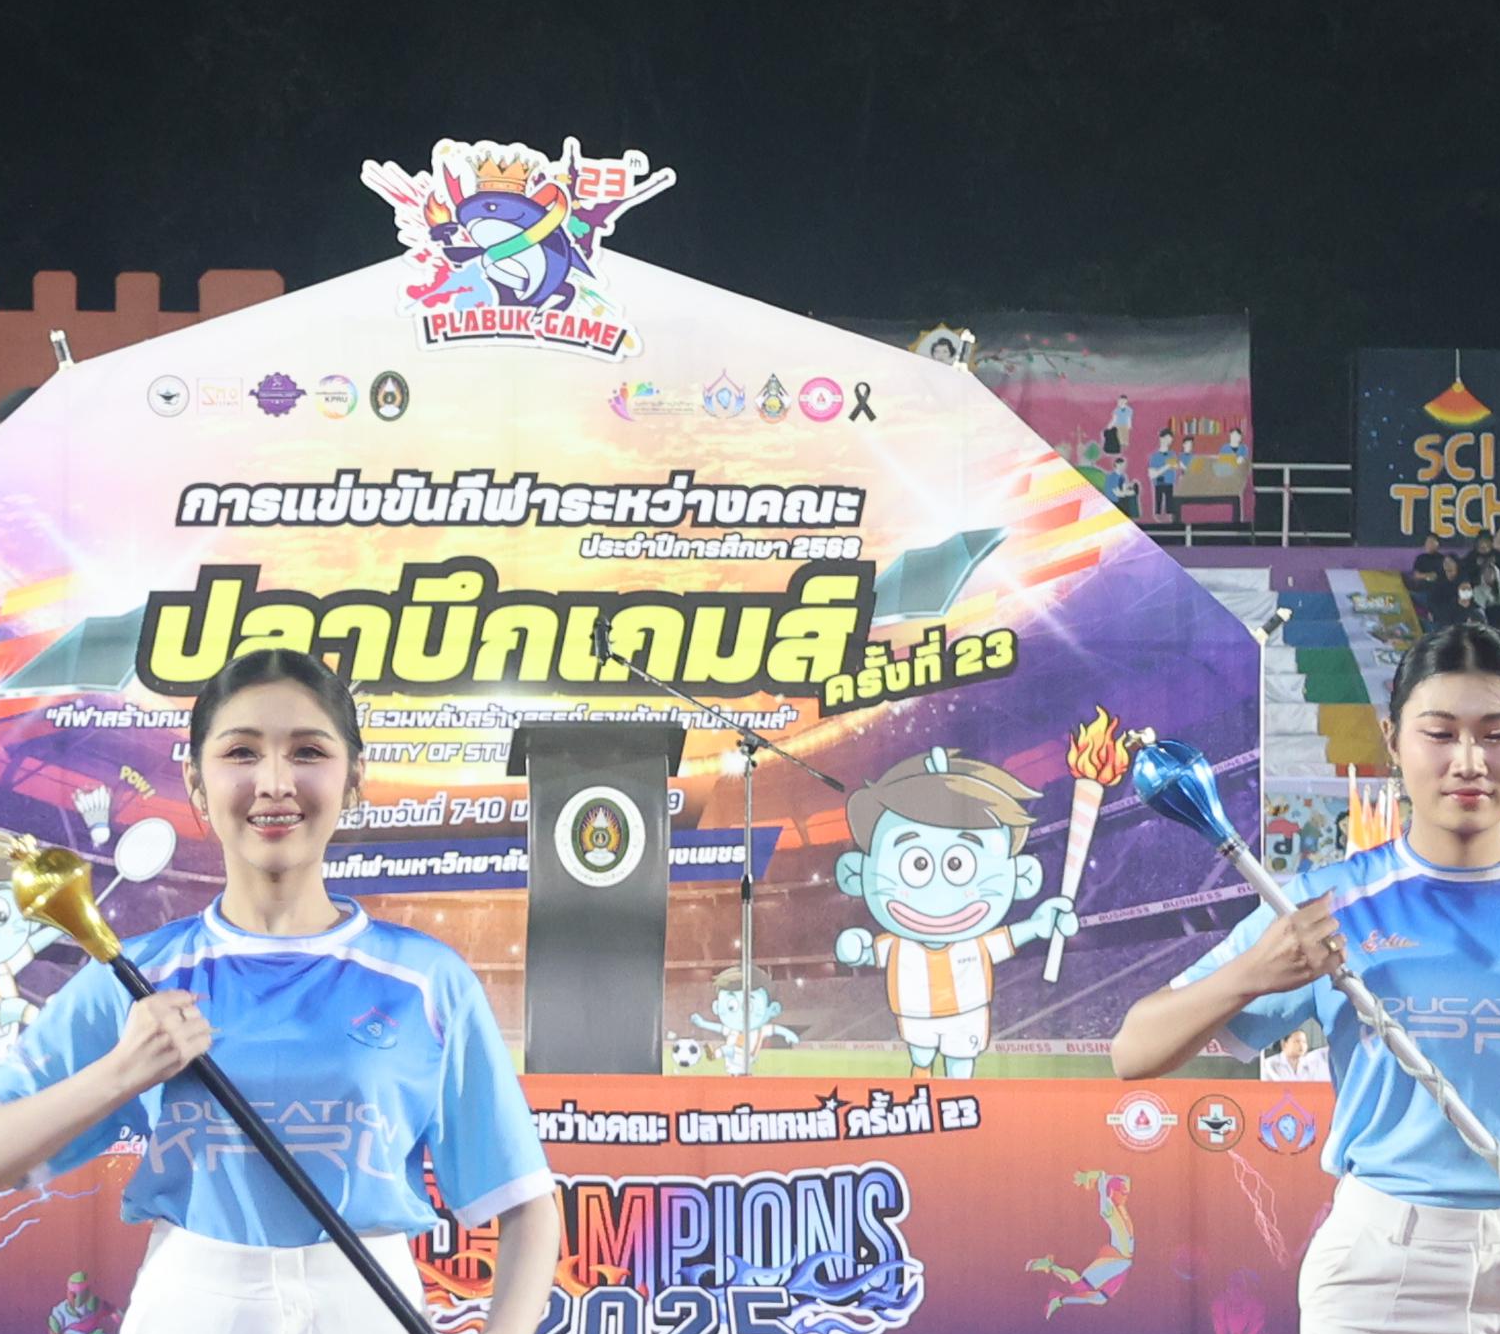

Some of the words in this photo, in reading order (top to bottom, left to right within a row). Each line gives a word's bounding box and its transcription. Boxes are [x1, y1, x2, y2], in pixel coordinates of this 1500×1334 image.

[577, 167, 627, 197] 23
[431, 308, 533, 336] PLABUK
[544, 312, 624, 347] GAME
[1414, 433, 1495, 481] SCI
[954, 631, 1015, 678] 23
[427, 743, 460, 762] OF
[995, 1042, 1052, 1054] BUSINESS
[1065, 1042, 1112, 1054] BUSIN
[941, 1098, 979, 1128] 23
